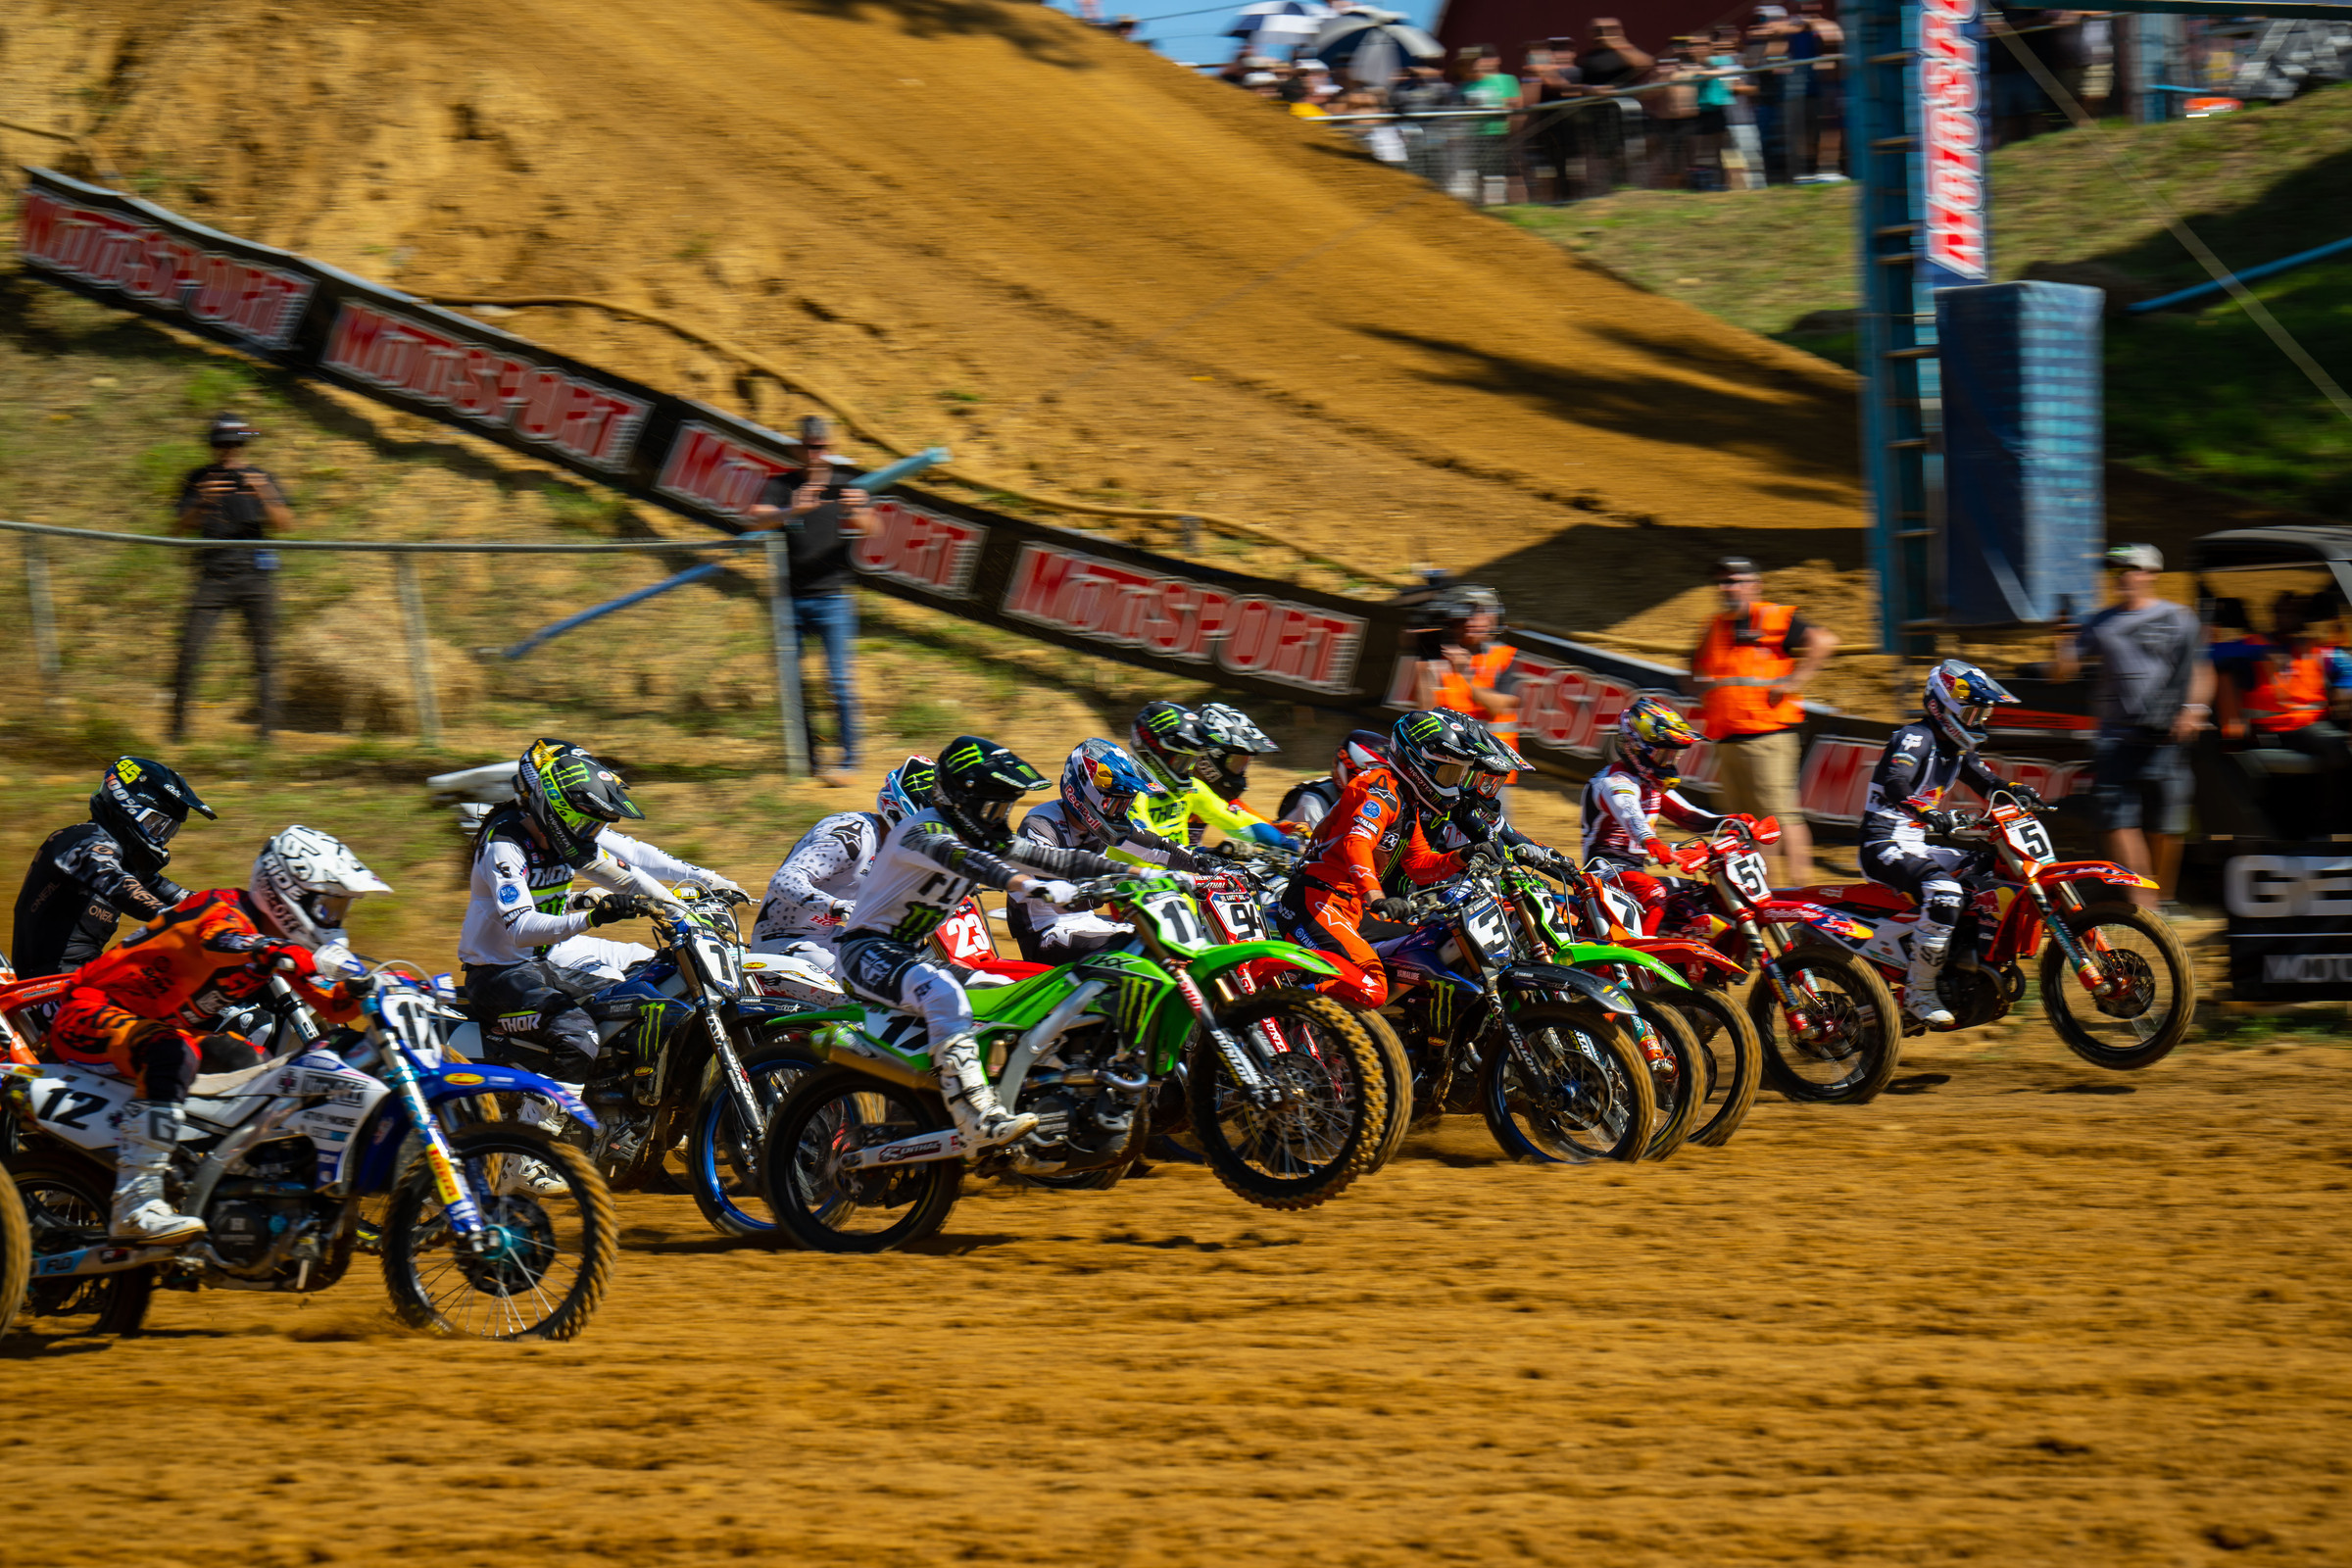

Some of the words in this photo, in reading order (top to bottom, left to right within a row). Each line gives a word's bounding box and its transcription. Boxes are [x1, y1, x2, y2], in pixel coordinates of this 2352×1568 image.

[318, 296, 654, 473] MOTOSPORT
[1002, 541, 1368, 695] MOTOSPORT
[105, 772, 143, 815] 100%
[1064, 784, 1084, 809] Red
[1080, 806, 1102, 831] Bull
[2019, 823, 2049, 858] 5
[946, 912, 991, 959] 23
[1478, 903, 1510, 956] 3
[709, 944, 734, 981] 1
[1506, 1022, 1540, 1076] DUNLOP
[37, 1087, 111, 1131] 12
